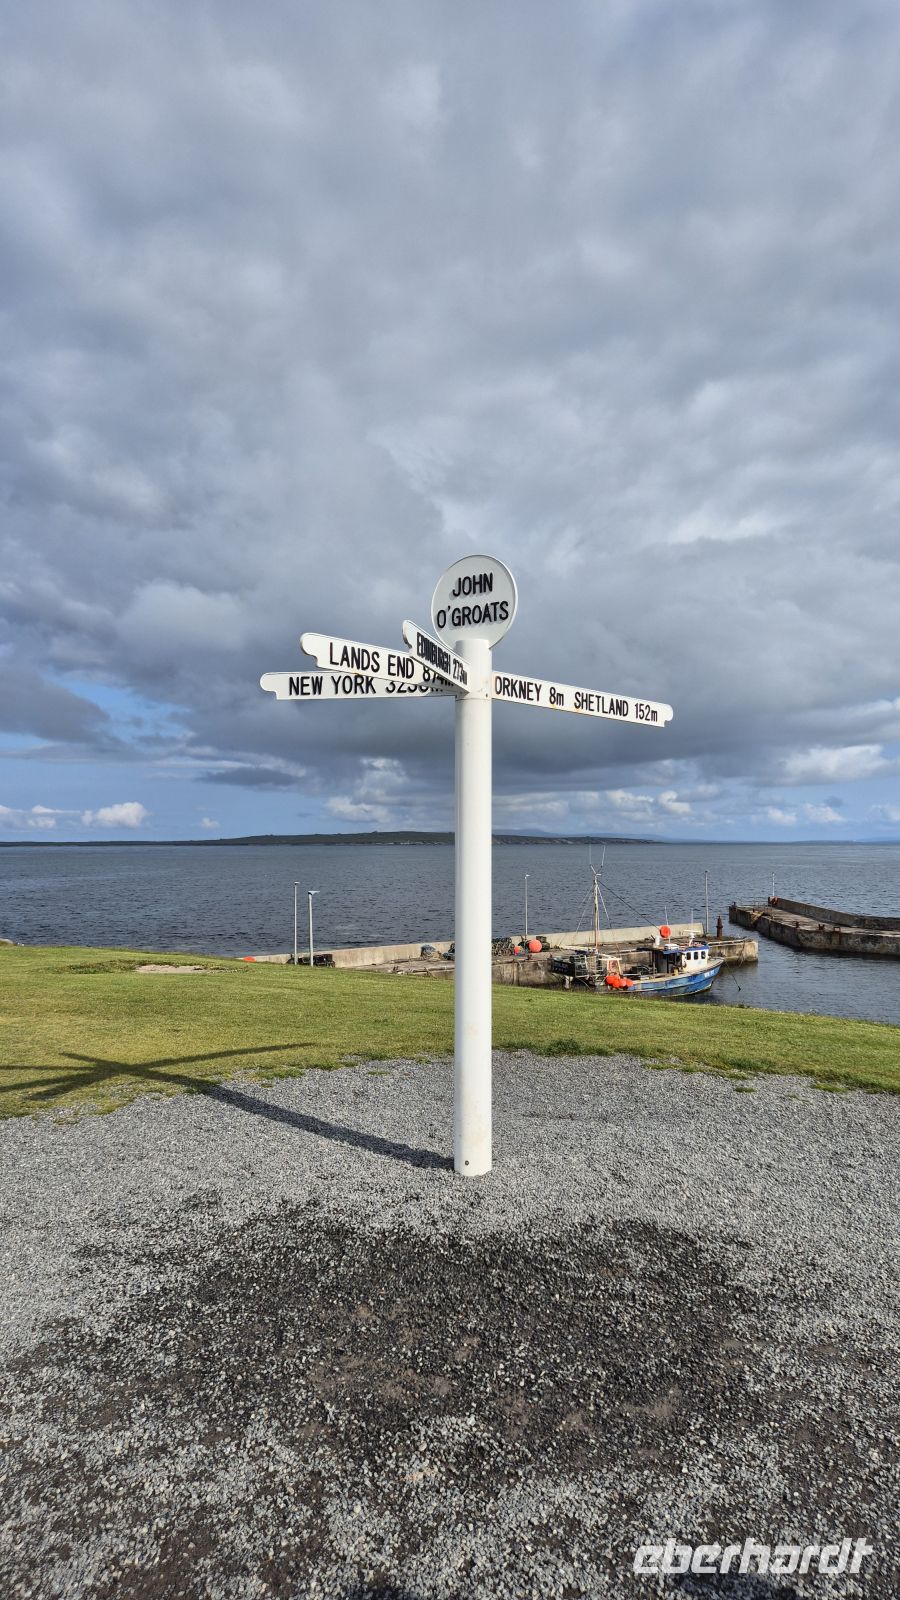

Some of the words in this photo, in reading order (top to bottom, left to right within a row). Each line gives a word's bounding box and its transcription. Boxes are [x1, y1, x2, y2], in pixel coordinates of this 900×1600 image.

[452, 572, 493, 597] JOHN
[436, 600, 509, 628] O'GROATS
[329, 642, 380, 673] LANDS
[388, 655, 415, 679] END
[423, 665, 454, 687] 874
[416, 631, 451, 674] EDINBURGH
[452, 658, 468, 685] 273m
[289, 675, 324, 695] NEW
[333, 674, 377, 694] YORK
[494, 675, 542, 703] ORKNEY
[548, 686, 565, 706] 8m
[574, 691, 629, 717] SHETLAND
[634, 702, 658, 722] 152m
